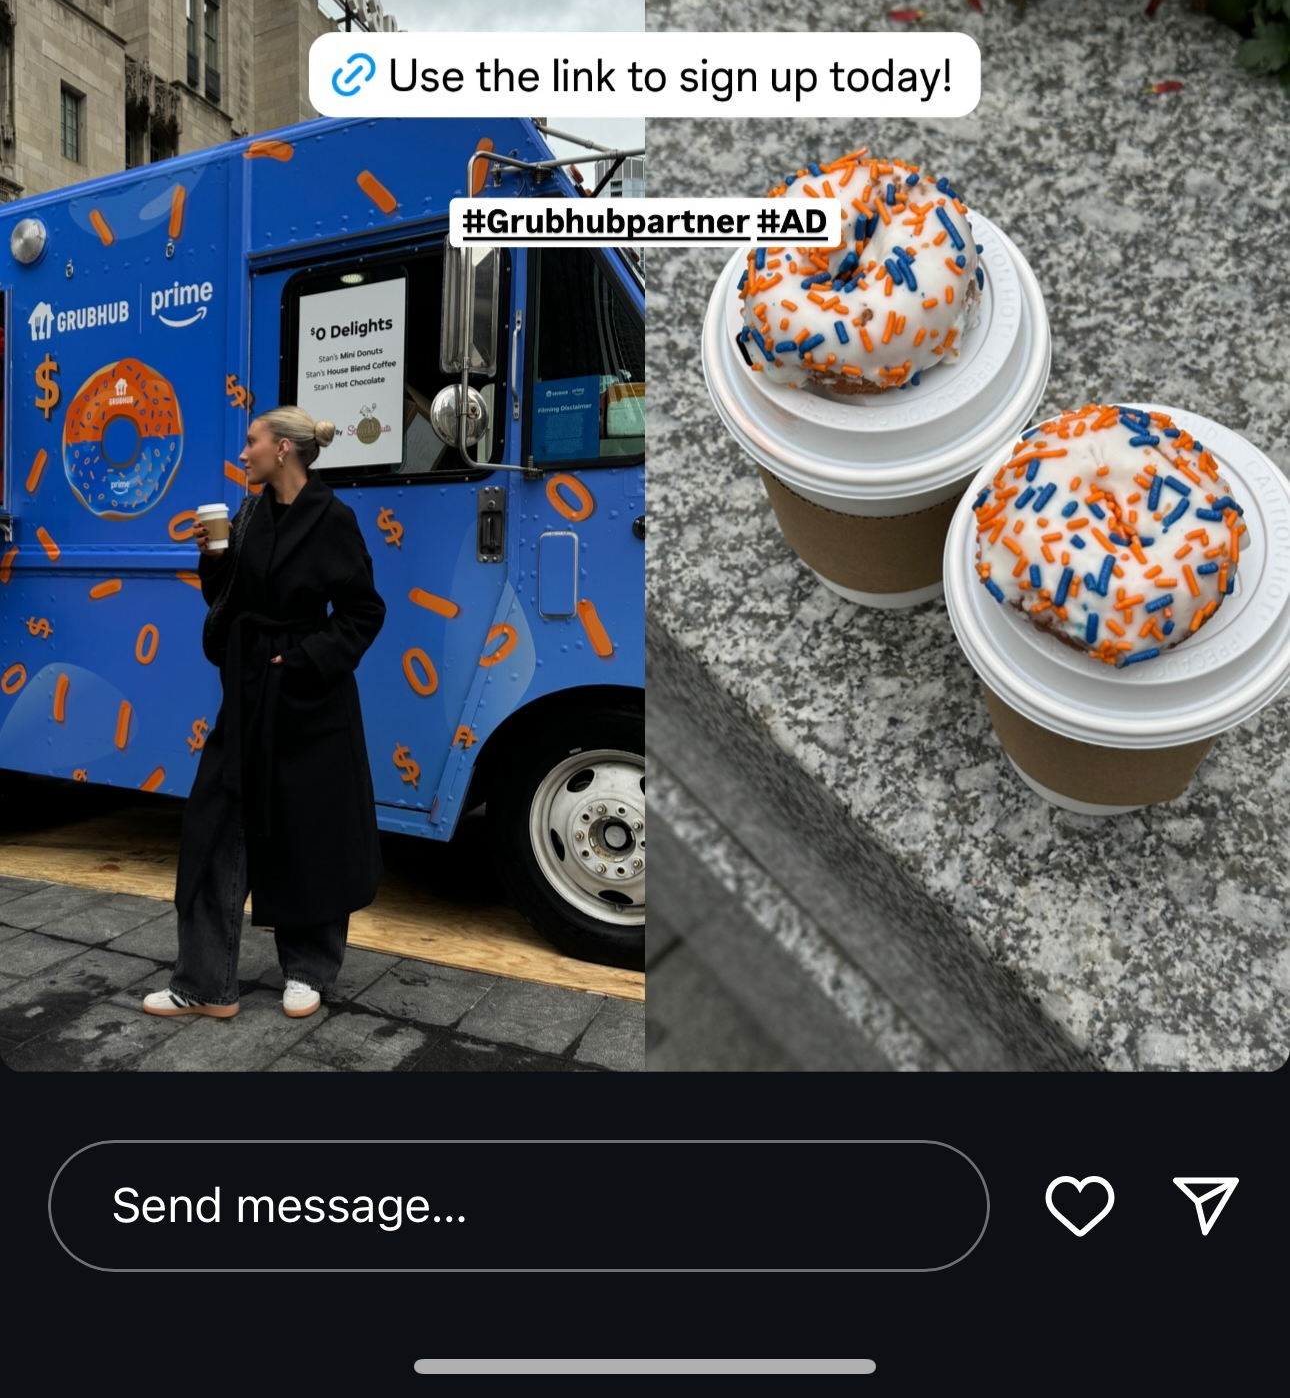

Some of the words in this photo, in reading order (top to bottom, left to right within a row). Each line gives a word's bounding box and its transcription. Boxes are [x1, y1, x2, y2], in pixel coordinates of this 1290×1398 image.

[57, 301, 129, 332] GRUBHUB
[151, 281, 213, 316] prime
[310, 327, 326, 341] $0
[330, 318, 393, 337] Delights
[318, 354, 338, 363] Stan's
[340, 351, 355, 360] Mini
[357, 347, 383, 357] Donuts
[305, 369, 325, 379] Stan's
[327, 367, 349, 376] House
[350, 363, 371, 373] Blend
[372, 360, 397, 370] Coffee
[313, 382, 333, 391] Stan's
[335, 380, 348, 389] Hot
[349, 376, 385, 387] Chocolate
[109, 396, 133, 406] GRUBHUB
[537, 405, 560, 414] Filming
[560, 403, 592, 412] Disclaimer
[110, 480, 130, 490] prime
